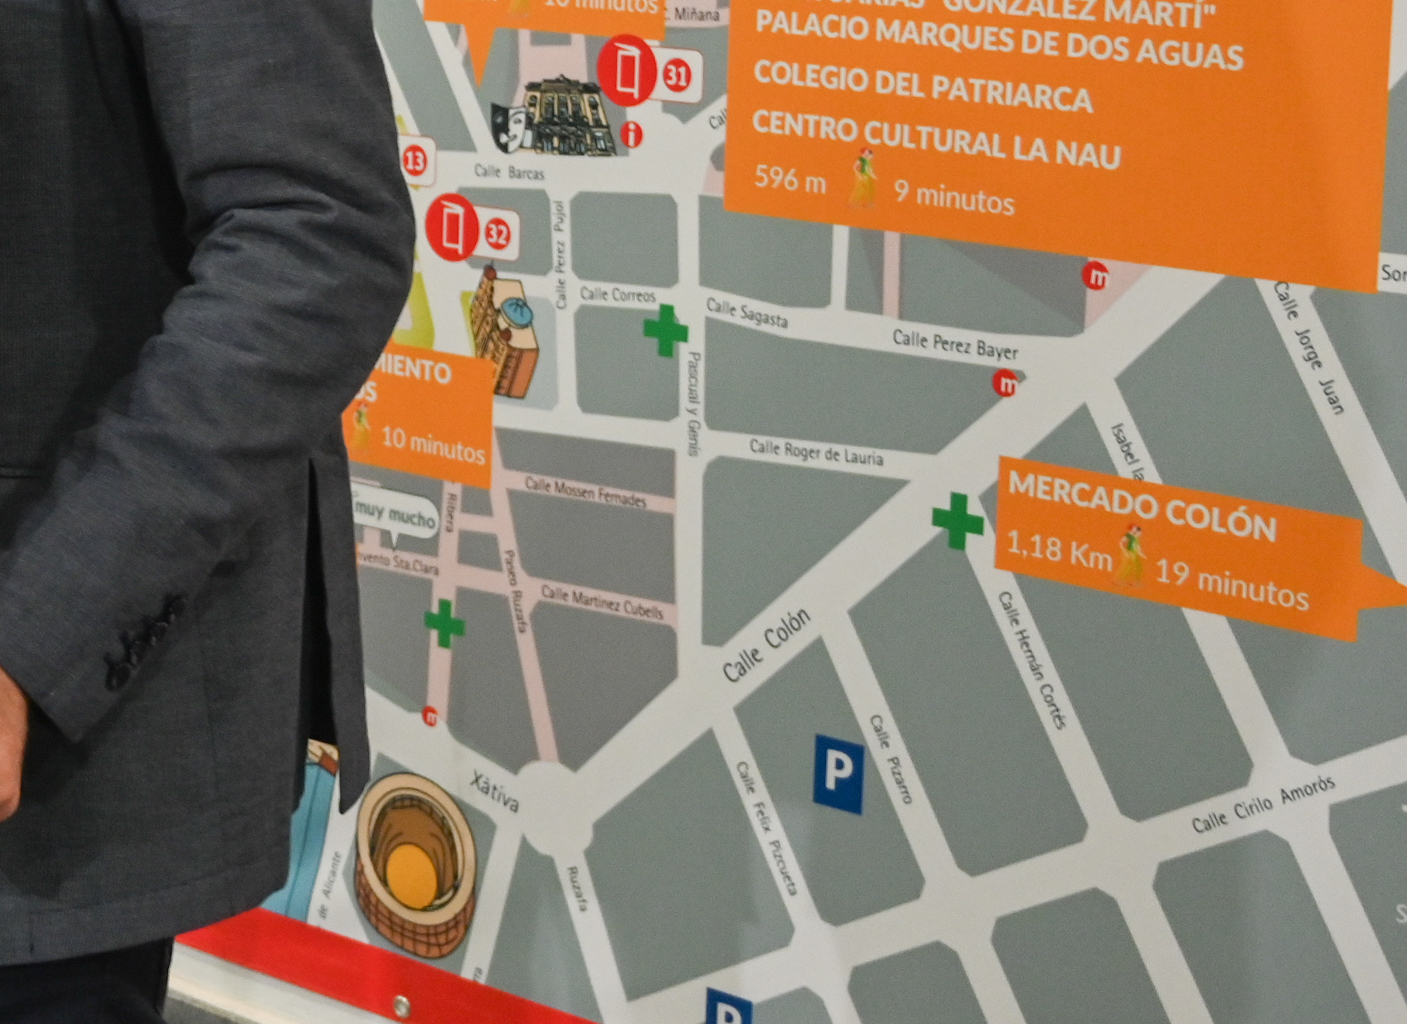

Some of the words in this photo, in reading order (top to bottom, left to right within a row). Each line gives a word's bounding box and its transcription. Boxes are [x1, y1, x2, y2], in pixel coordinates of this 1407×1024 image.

[666, 66, 688, 87] 31
[752, 109, 858, 142] CENTRO
[864, 120, 1007, 159] CULTURAL
[1013, 136, 1050, 164] LA
[1056, 139, 1122, 171] NAU
[487, 223, 508, 244] 32
[892, 328, 928, 350] Calle
[933, 334, 972, 356] Perez
[976, 341, 1019, 362] Bayer
[749, 438, 781, 457] Calle
[784, 442, 821, 463] Roger
[824, 446, 841, 463] de
[844, 449, 884, 468] Lauria
[355, 499, 386, 518] muy
[388, 503, 436, 530] mucho
[1008, 469, 1159, 520] MERCADO
[1166, 503, 1277, 543] COLÓN
[1008, 529, 1064, 561] 1,18
[1071, 540, 1114, 573] Km
[1156, 557, 1191, 587] 19
[1198, 570, 1310, 612] minutos
[723, 644, 765, 683] Calle
[763, 607, 812, 651] Colón
[999, 590, 1020, 629] Calle
[1015, 628, 1045, 682] Hernán
[1039, 683, 1067, 731] Cortés
[1192, 811, 1229, 835] Calle
[1233, 796, 1274, 820] Cirilo
